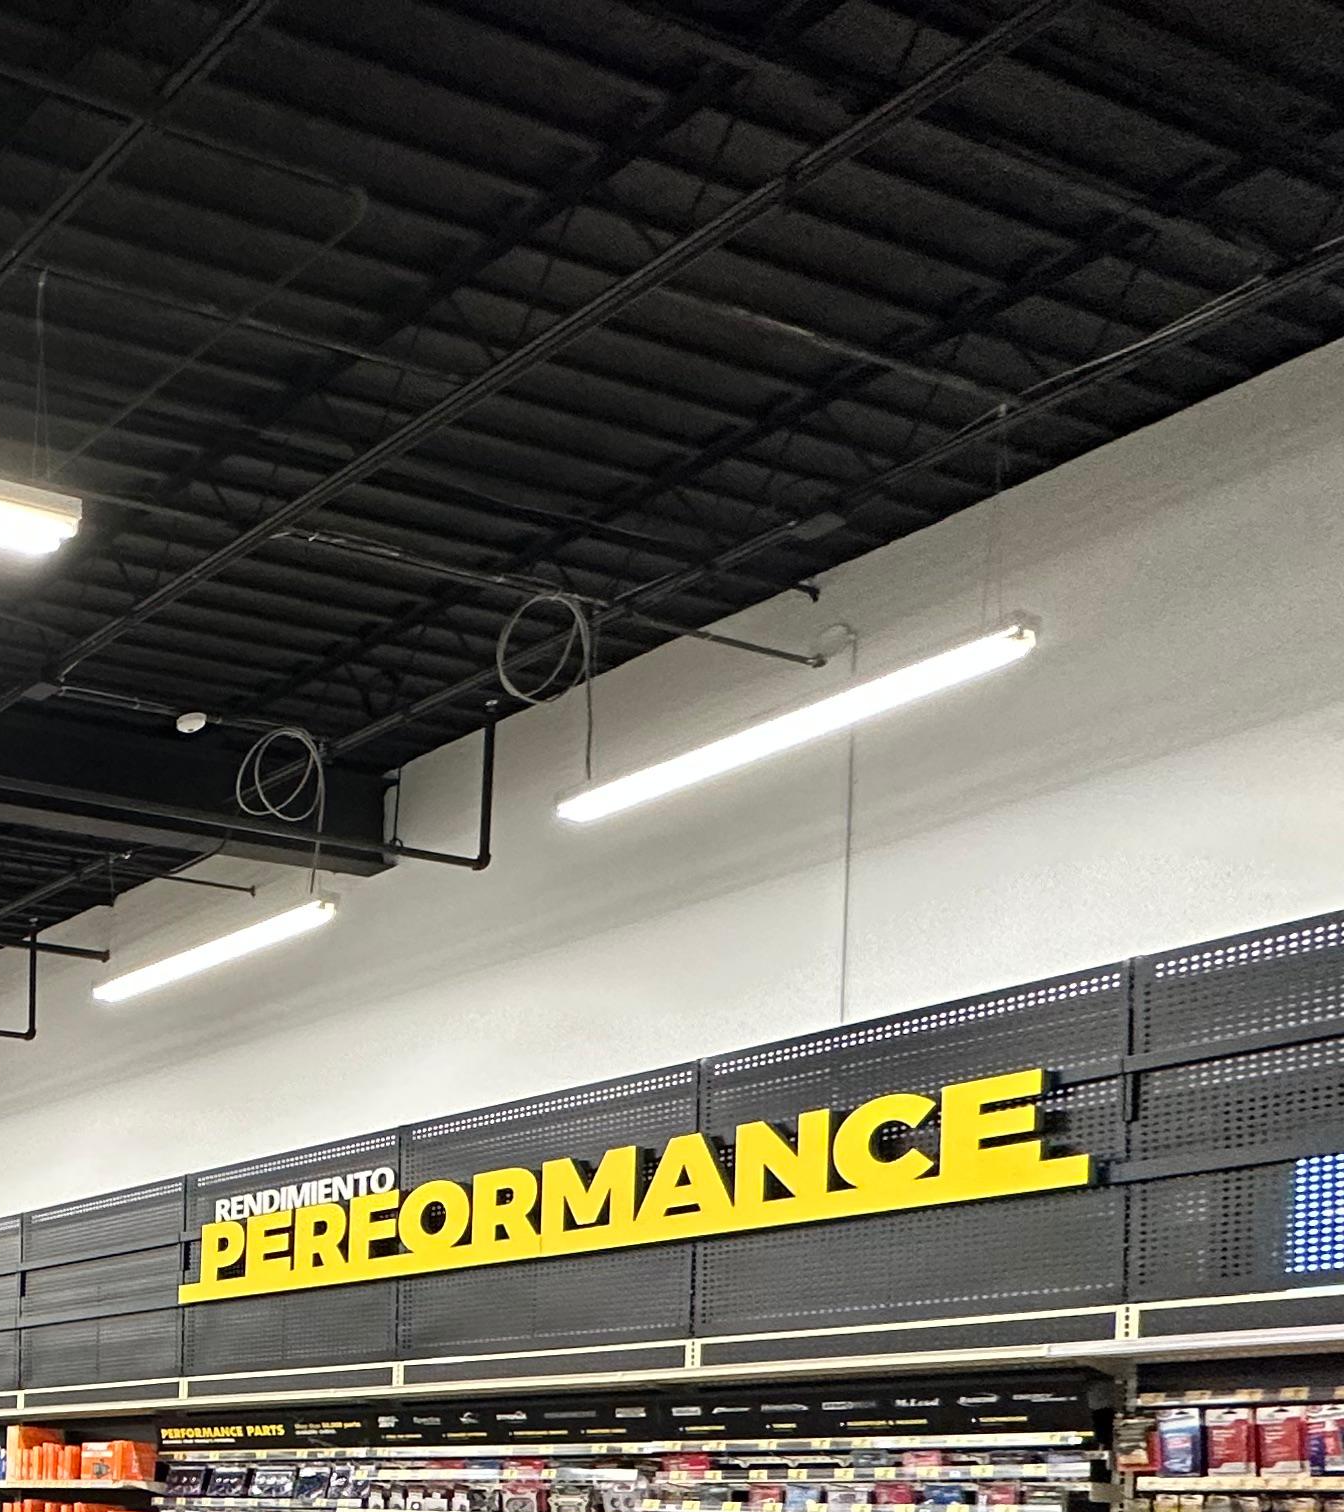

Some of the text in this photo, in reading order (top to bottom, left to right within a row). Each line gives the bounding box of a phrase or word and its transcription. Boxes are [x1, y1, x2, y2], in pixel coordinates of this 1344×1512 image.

[201, 1068, 1053, 1284] PERFORMANCE
[215, 1168, 395, 1221] RENDIMIENTO
[161, 1426, 243, 1439] PERFORMANCE
[247, 1425, 285, 1437] PARTS
